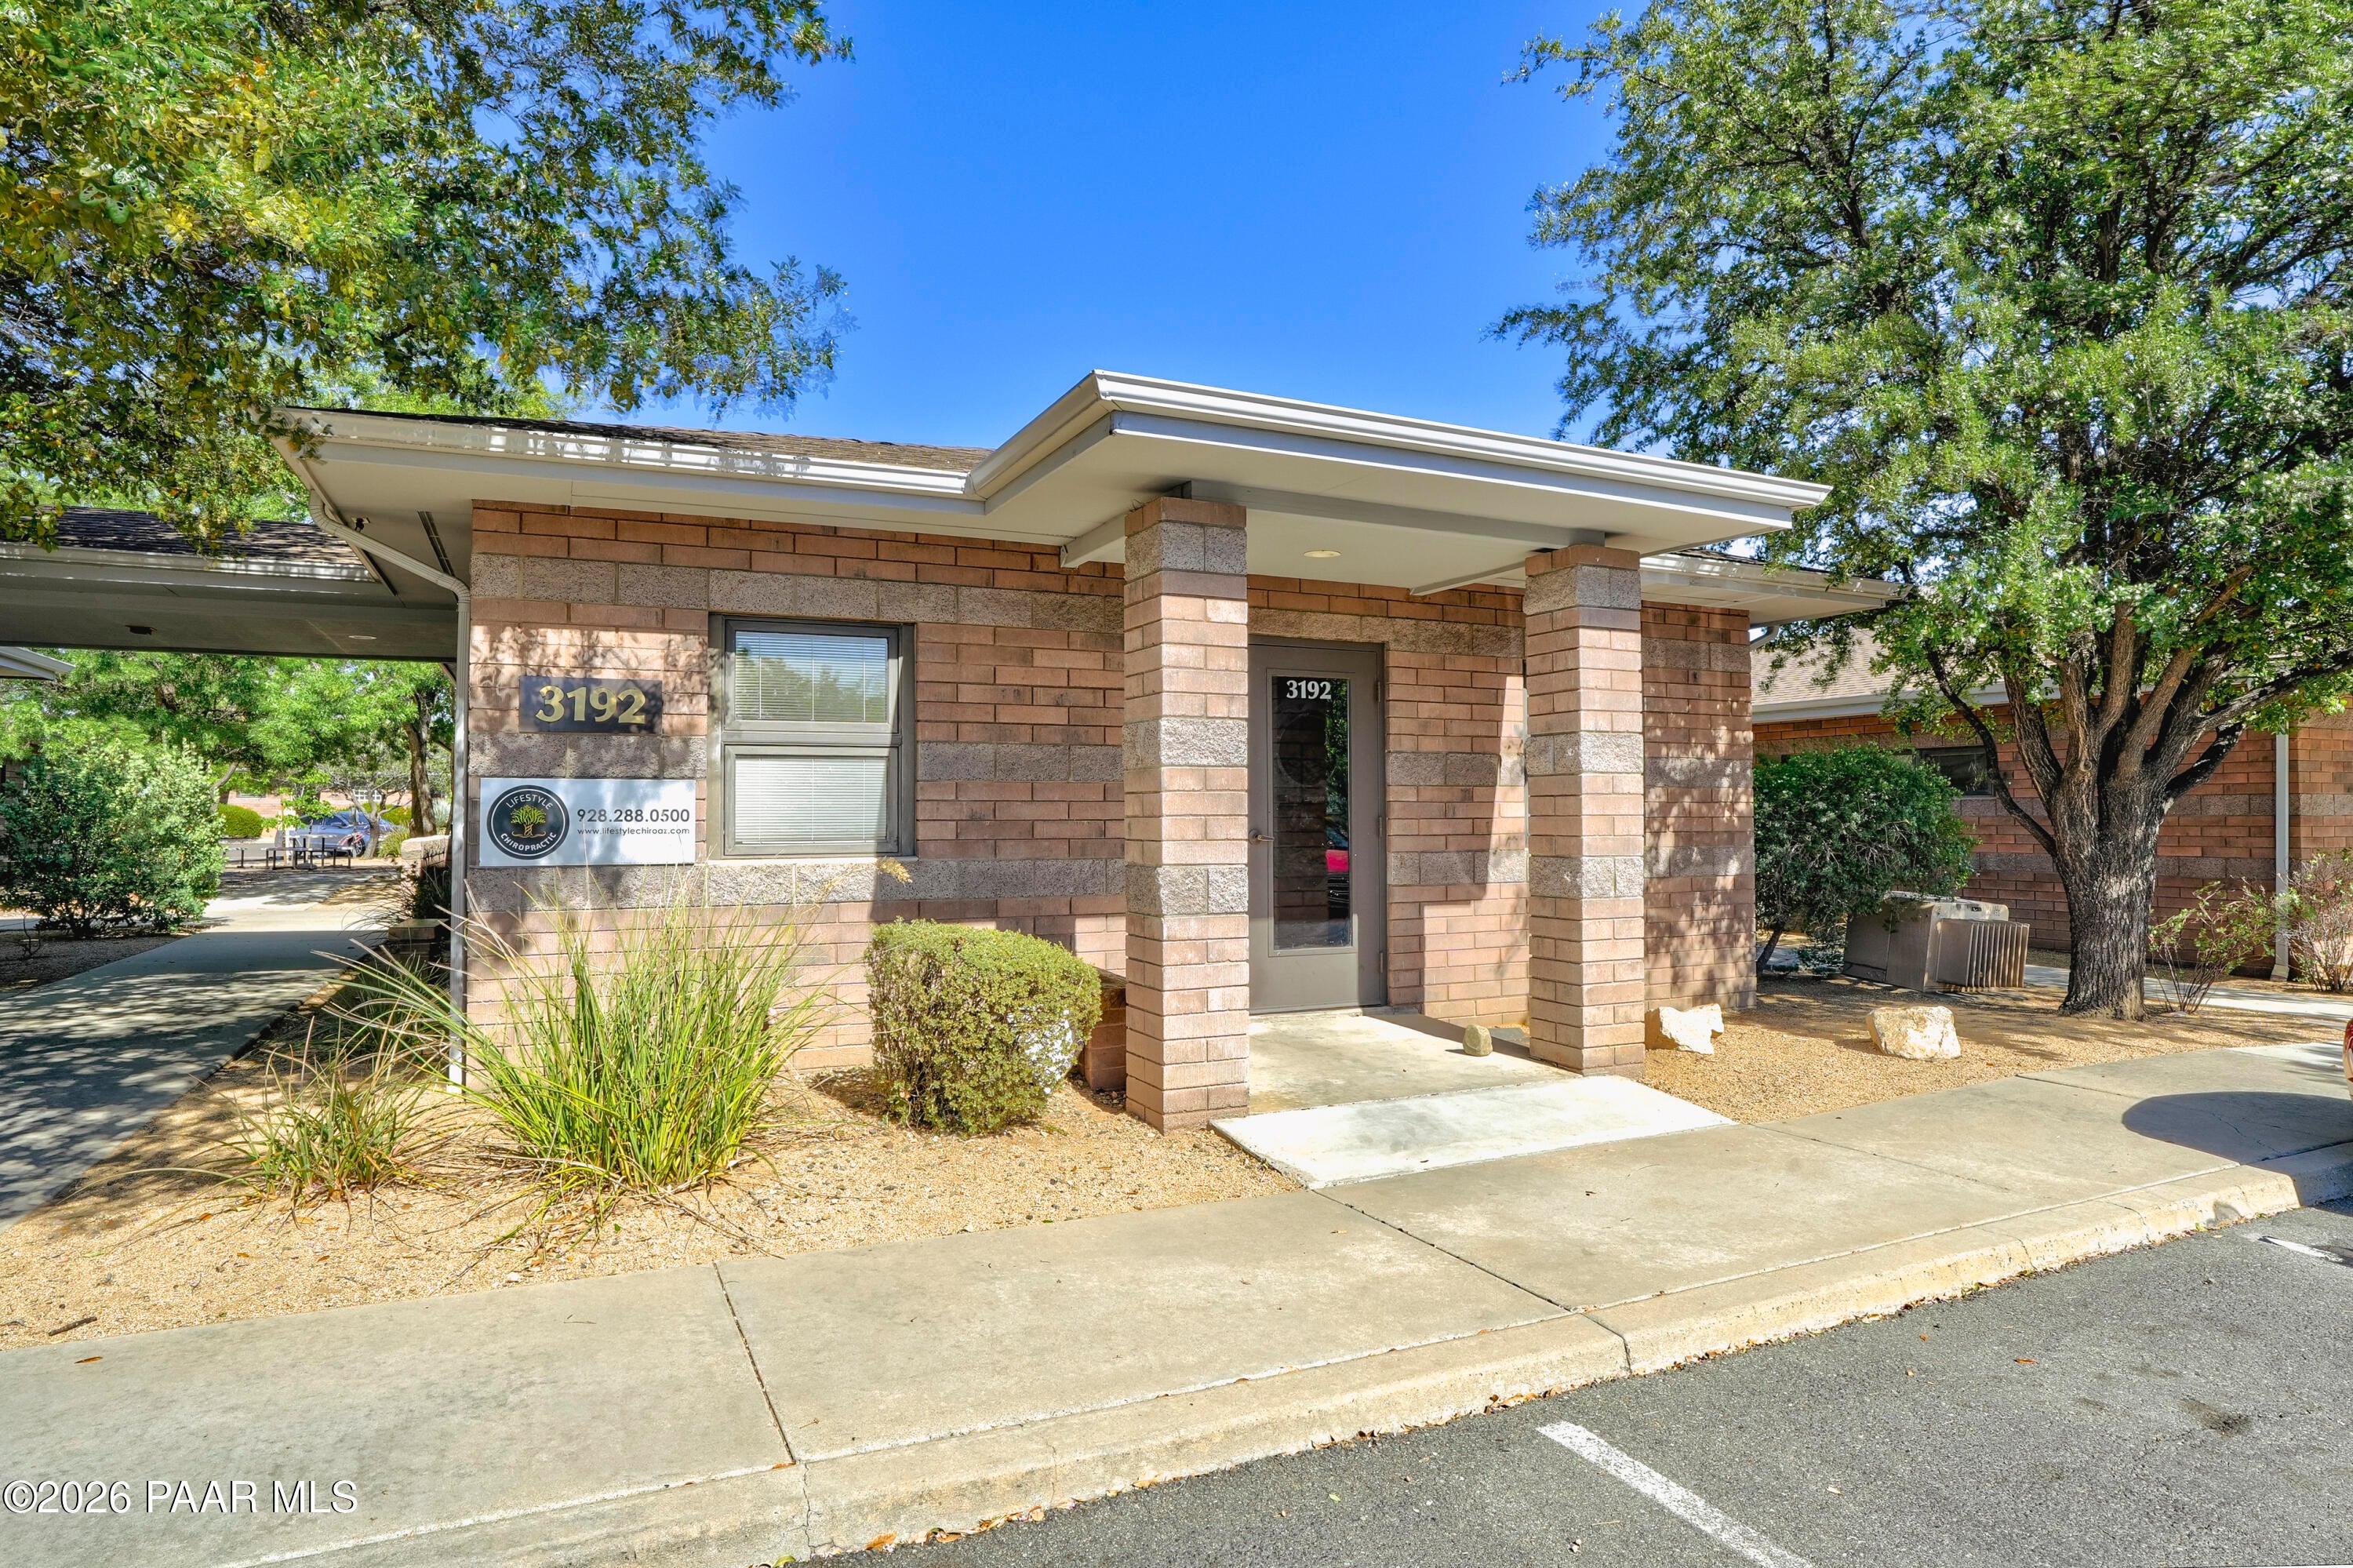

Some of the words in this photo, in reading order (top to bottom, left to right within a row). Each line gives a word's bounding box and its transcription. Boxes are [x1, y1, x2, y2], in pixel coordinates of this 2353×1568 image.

[1286, 679, 1332, 700] 3192
[535, 685, 646, 724] 3192
[506, 794, 554, 810] LIFESTYLE
[577, 809, 690, 822] 928.288.0500
[577, 827, 690, 836] www.lifestylechiroaz.com
[500, 831, 557, 851] CHIROPRACTIC
